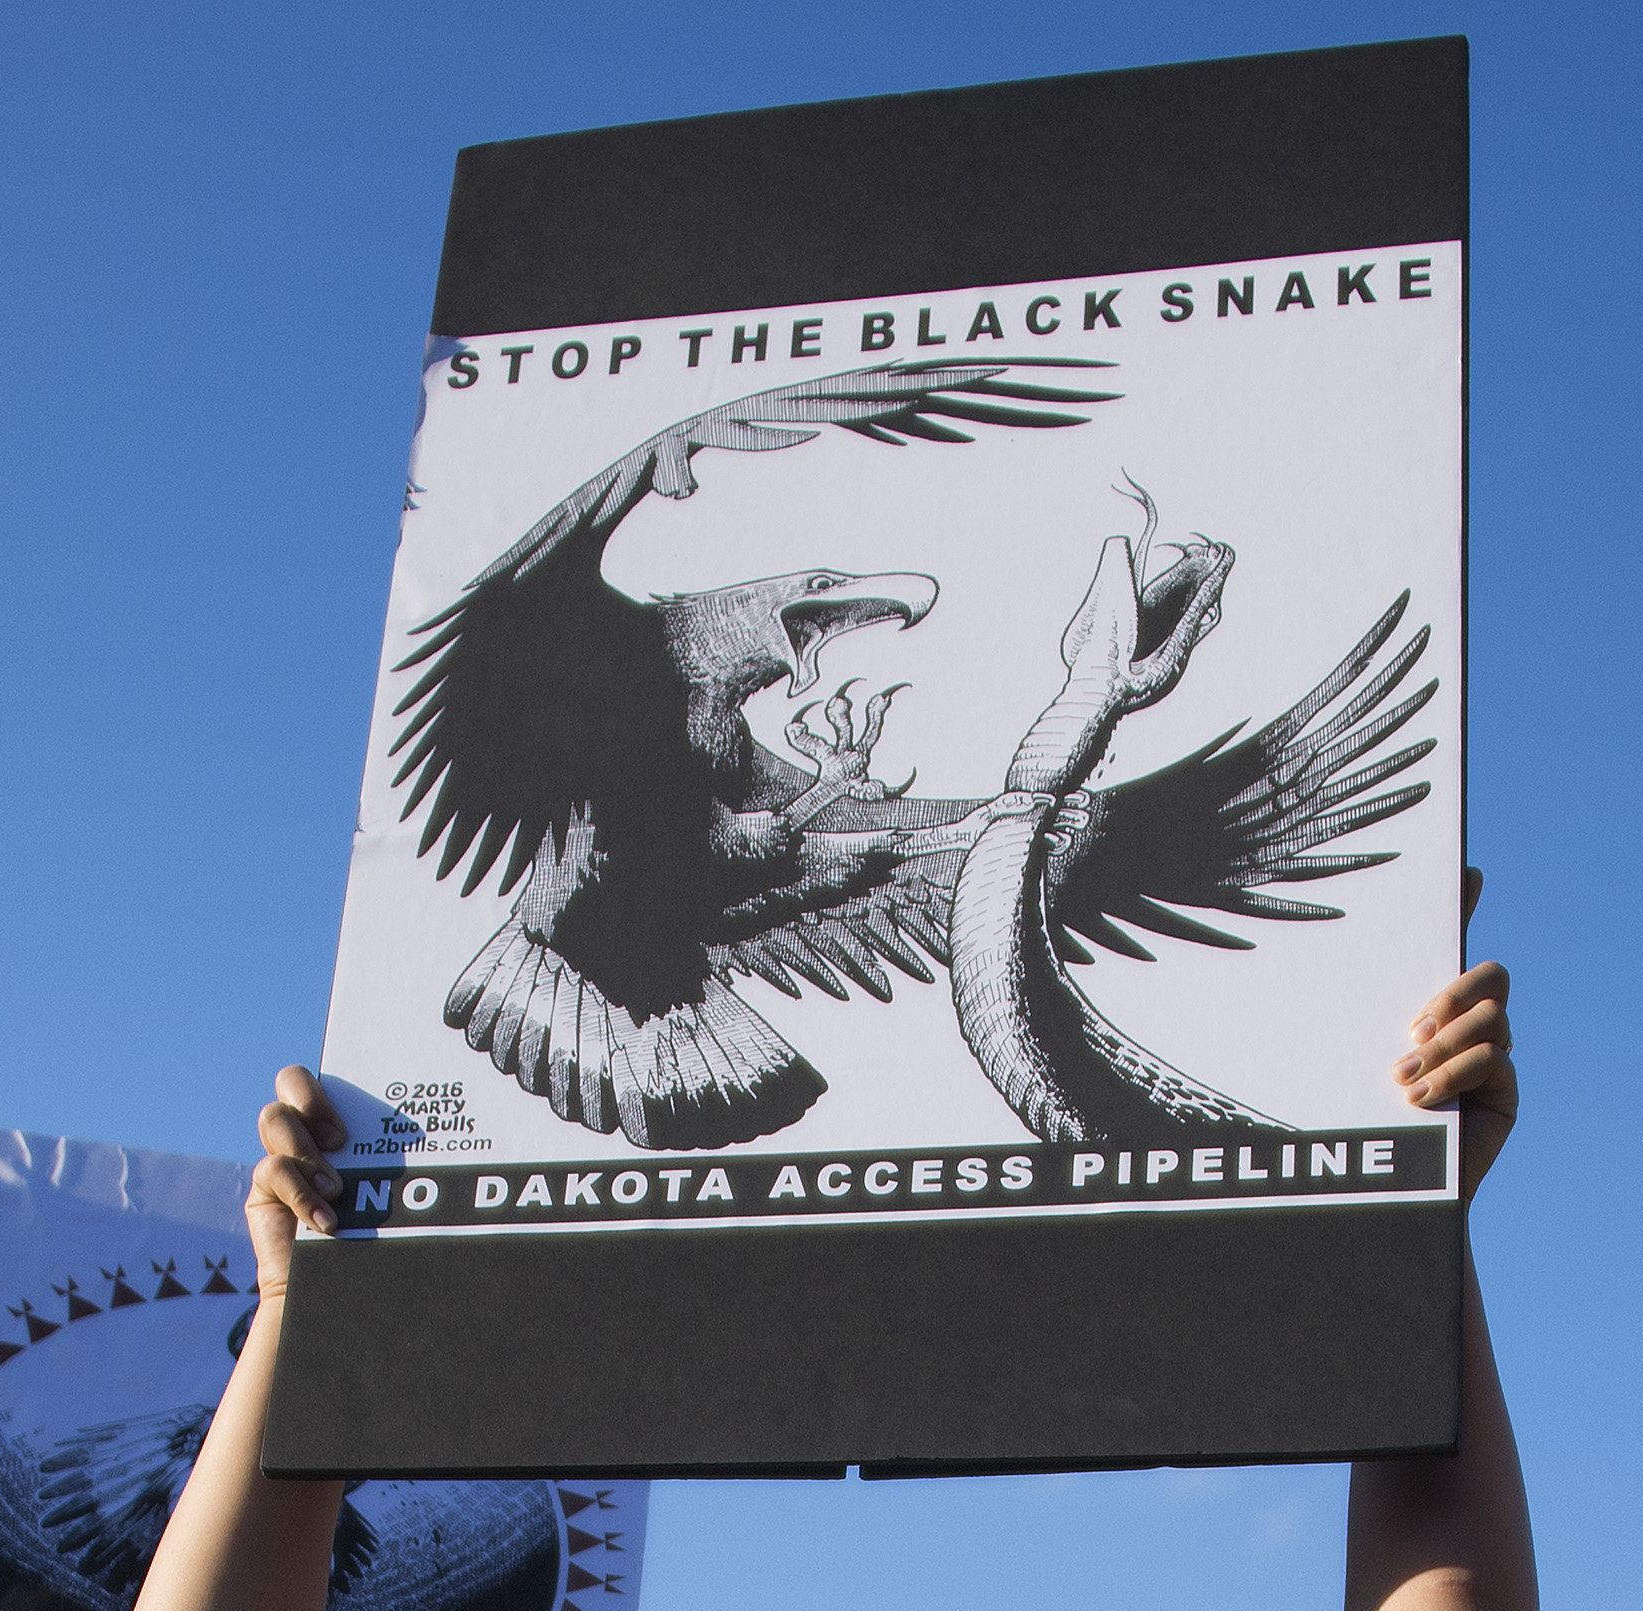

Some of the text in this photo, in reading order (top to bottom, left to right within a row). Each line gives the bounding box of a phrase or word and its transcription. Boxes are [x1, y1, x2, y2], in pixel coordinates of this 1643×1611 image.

[446, 256, 1435, 391] STOP THE BLACK SNAKE
[393, 1099, 466, 1116] MARTY
[381, 1115, 476, 1134] Two Bulls
[353, 1136, 493, 1156] m2bulls.com
[354, 1139, 1396, 1212] NO DAKOTA ACCESS PIPELINE
